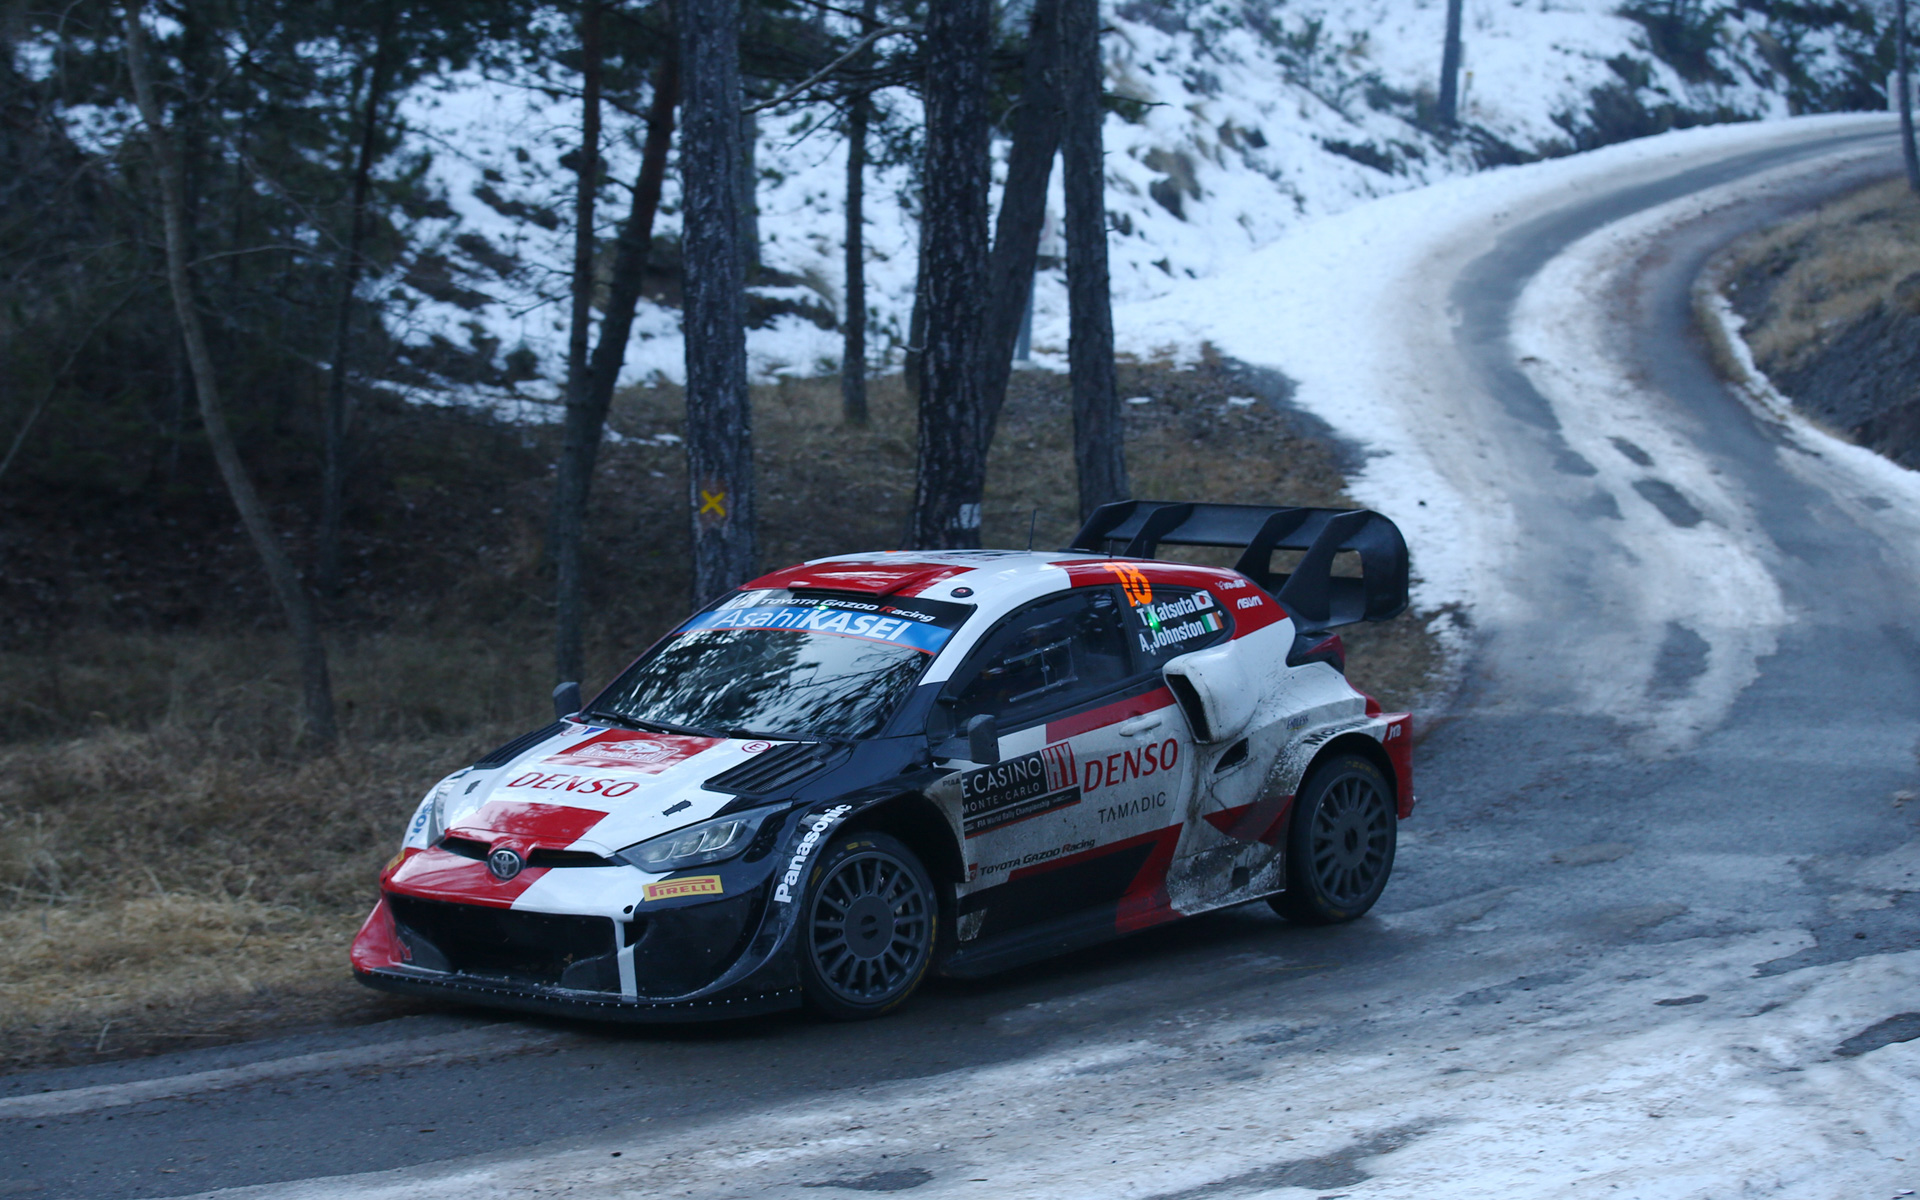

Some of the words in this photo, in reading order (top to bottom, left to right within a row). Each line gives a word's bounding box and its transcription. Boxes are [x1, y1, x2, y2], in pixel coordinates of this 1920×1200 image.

[1103, 562, 1153, 607] 18
[713, 607, 912, 641] AsahiKASEI
[760, 597, 818, 606] TOYOTA
[820, 598, 879, 612] GAZOO
[879, 605, 937, 623] Racing
[973, 757, 1042, 794] CASINO
[1083, 737, 1179, 794] DENSO
[505, 771, 641, 798] DENSO
[1098, 791, 1167, 825] TAMADIC
[773, 803, 853, 904] Panasonic
[980, 859, 1021, 876] TOYOTA
[1022, 848, 1061, 864] GAZOO
[1062, 838, 1096, 855] Racing
[648, 878, 717, 898] PIRELLI
